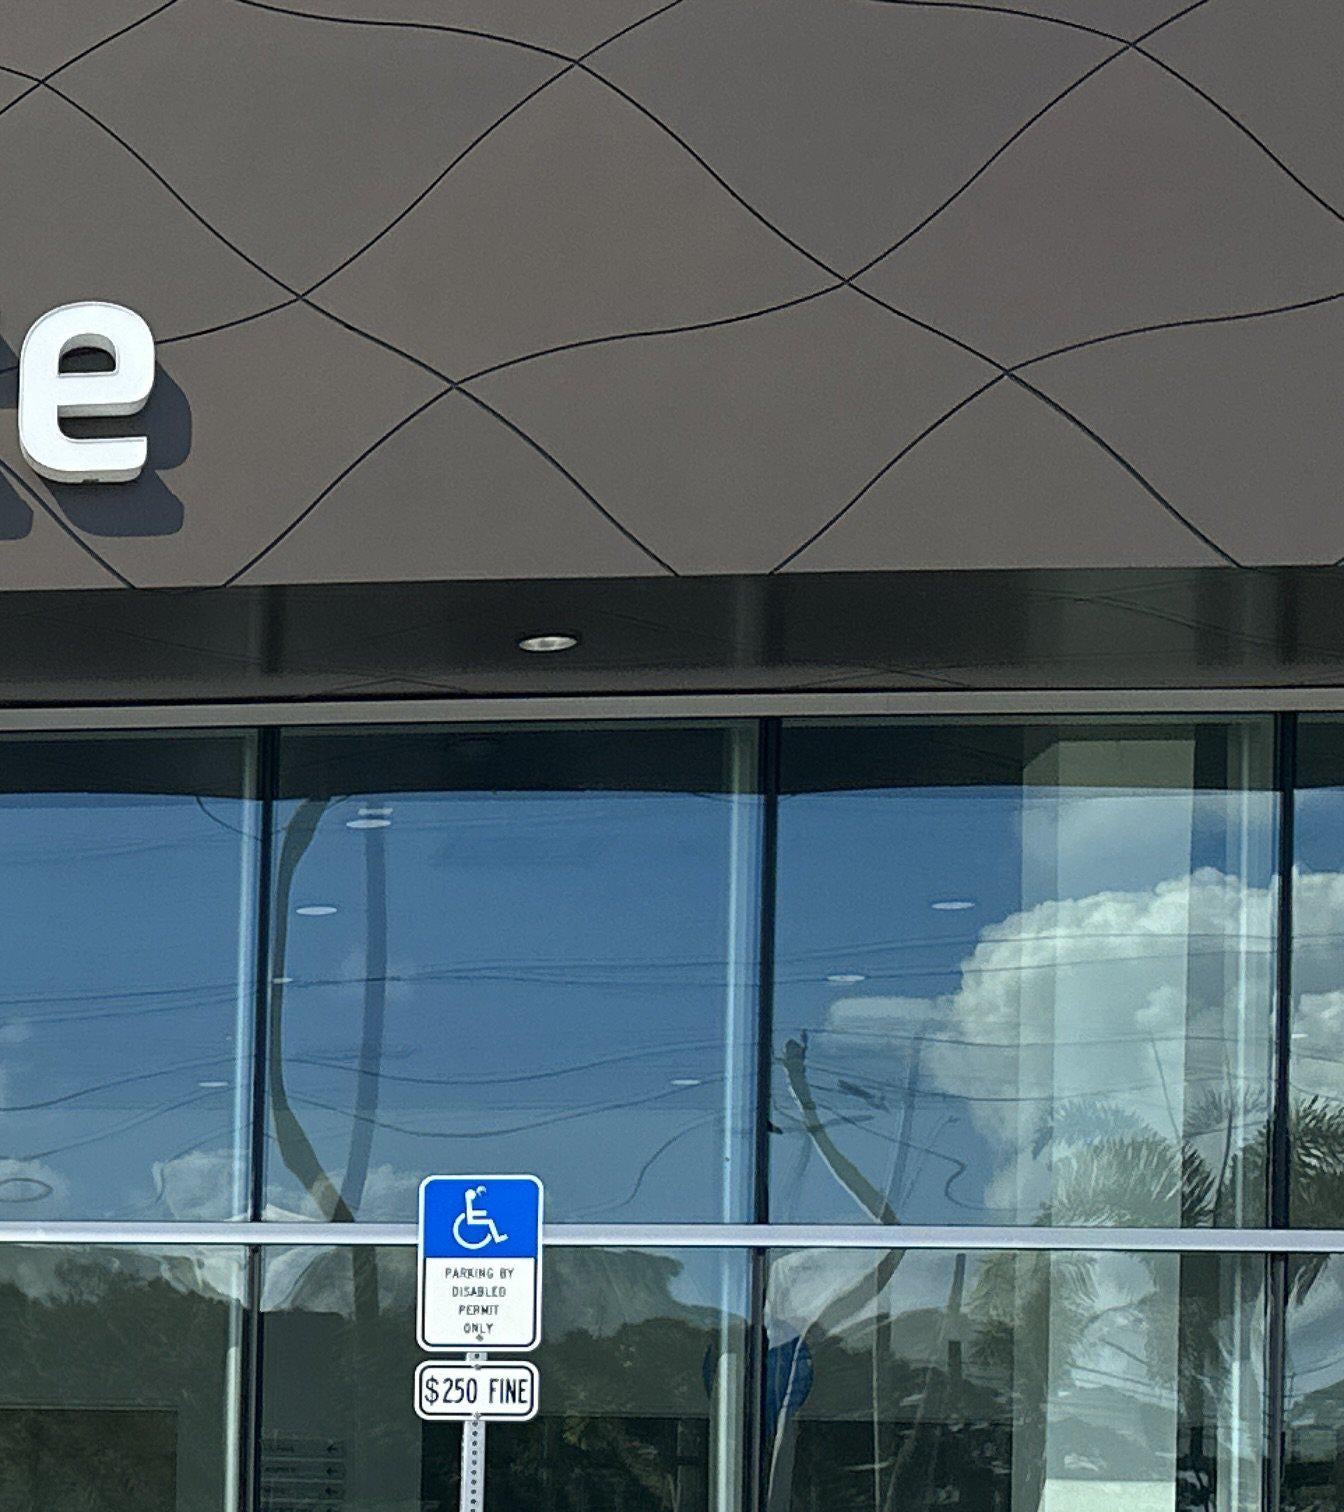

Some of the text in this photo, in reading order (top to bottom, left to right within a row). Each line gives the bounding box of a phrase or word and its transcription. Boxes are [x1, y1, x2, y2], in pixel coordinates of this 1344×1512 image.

[445, 1267, 515, 1279] PARKING BY
[452, 1286, 507, 1298] DISABLED
[458, 1304, 500, 1316] PERMIT
[463, 1322, 494, 1334] ONLY
[424, 1375, 528, 1406] $250 FINE
